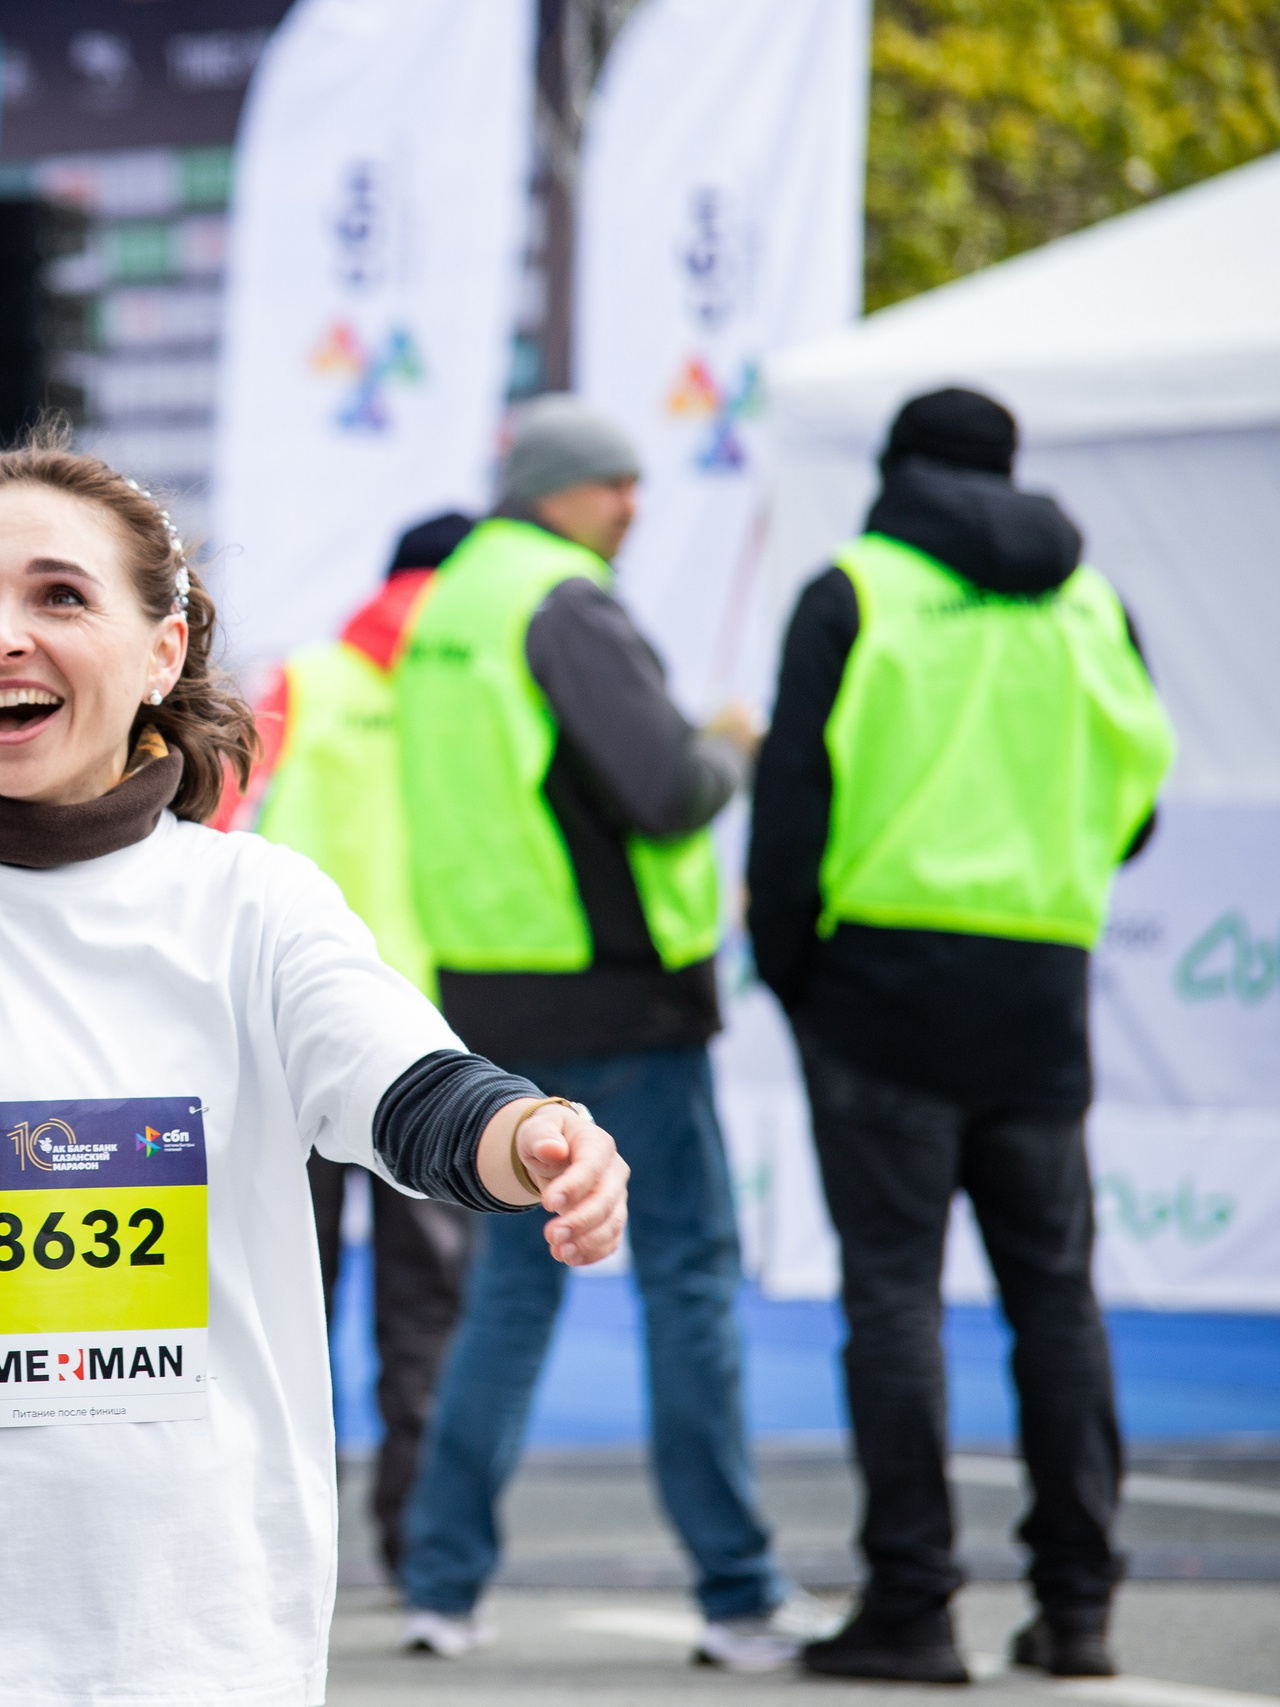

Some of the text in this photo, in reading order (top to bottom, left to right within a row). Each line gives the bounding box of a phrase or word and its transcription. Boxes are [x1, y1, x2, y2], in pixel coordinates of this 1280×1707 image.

[52, 1143, 118, 1153] АК БАРС БАНК
[52, 1152, 110, 1162] КАЗАНСКИЙ
[52, 1161, 99, 1171] МАРАФОН
[12, 1407, 127, 1419] Питание после финиша
